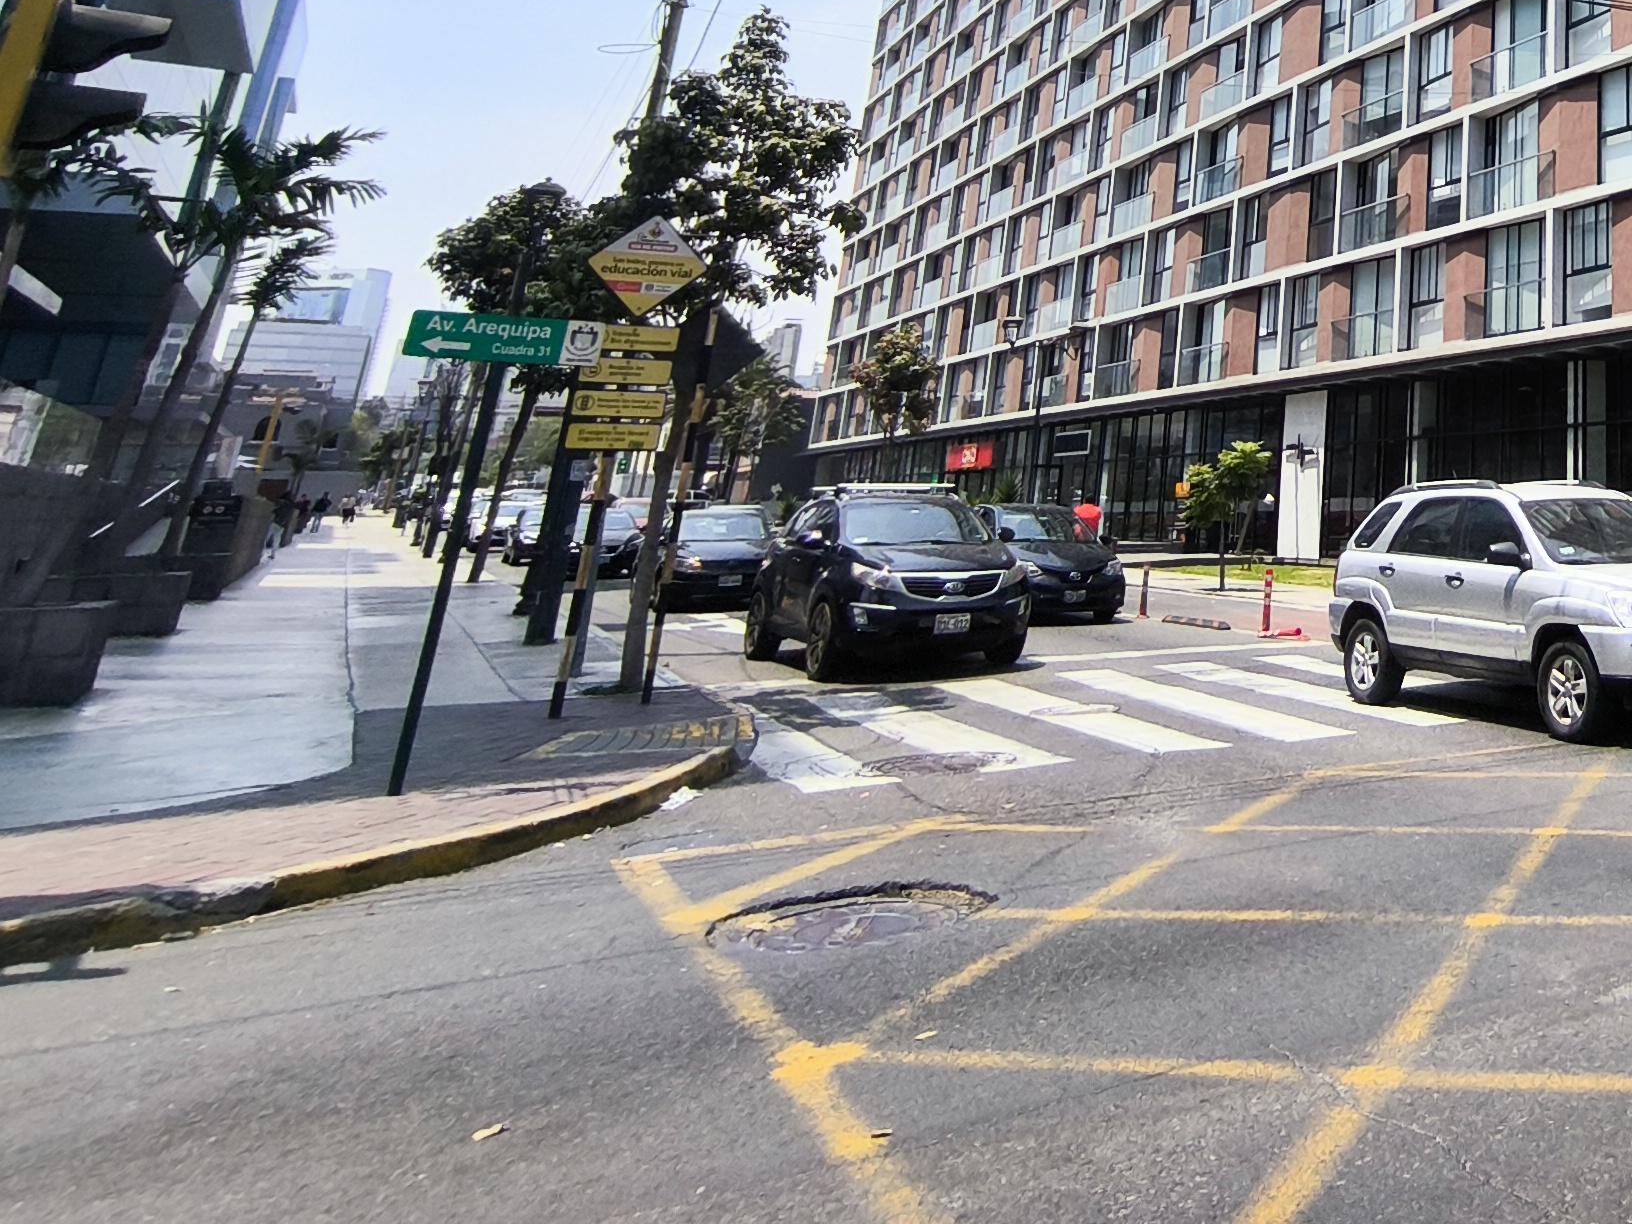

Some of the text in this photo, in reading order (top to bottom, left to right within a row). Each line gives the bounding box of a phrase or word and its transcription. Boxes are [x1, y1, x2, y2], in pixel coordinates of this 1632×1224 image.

[600, 263, 694, 279] educación vial
[426, 314, 552, 341] Av. Arequipa
[491, 342, 551, 357] Cuadra 31
